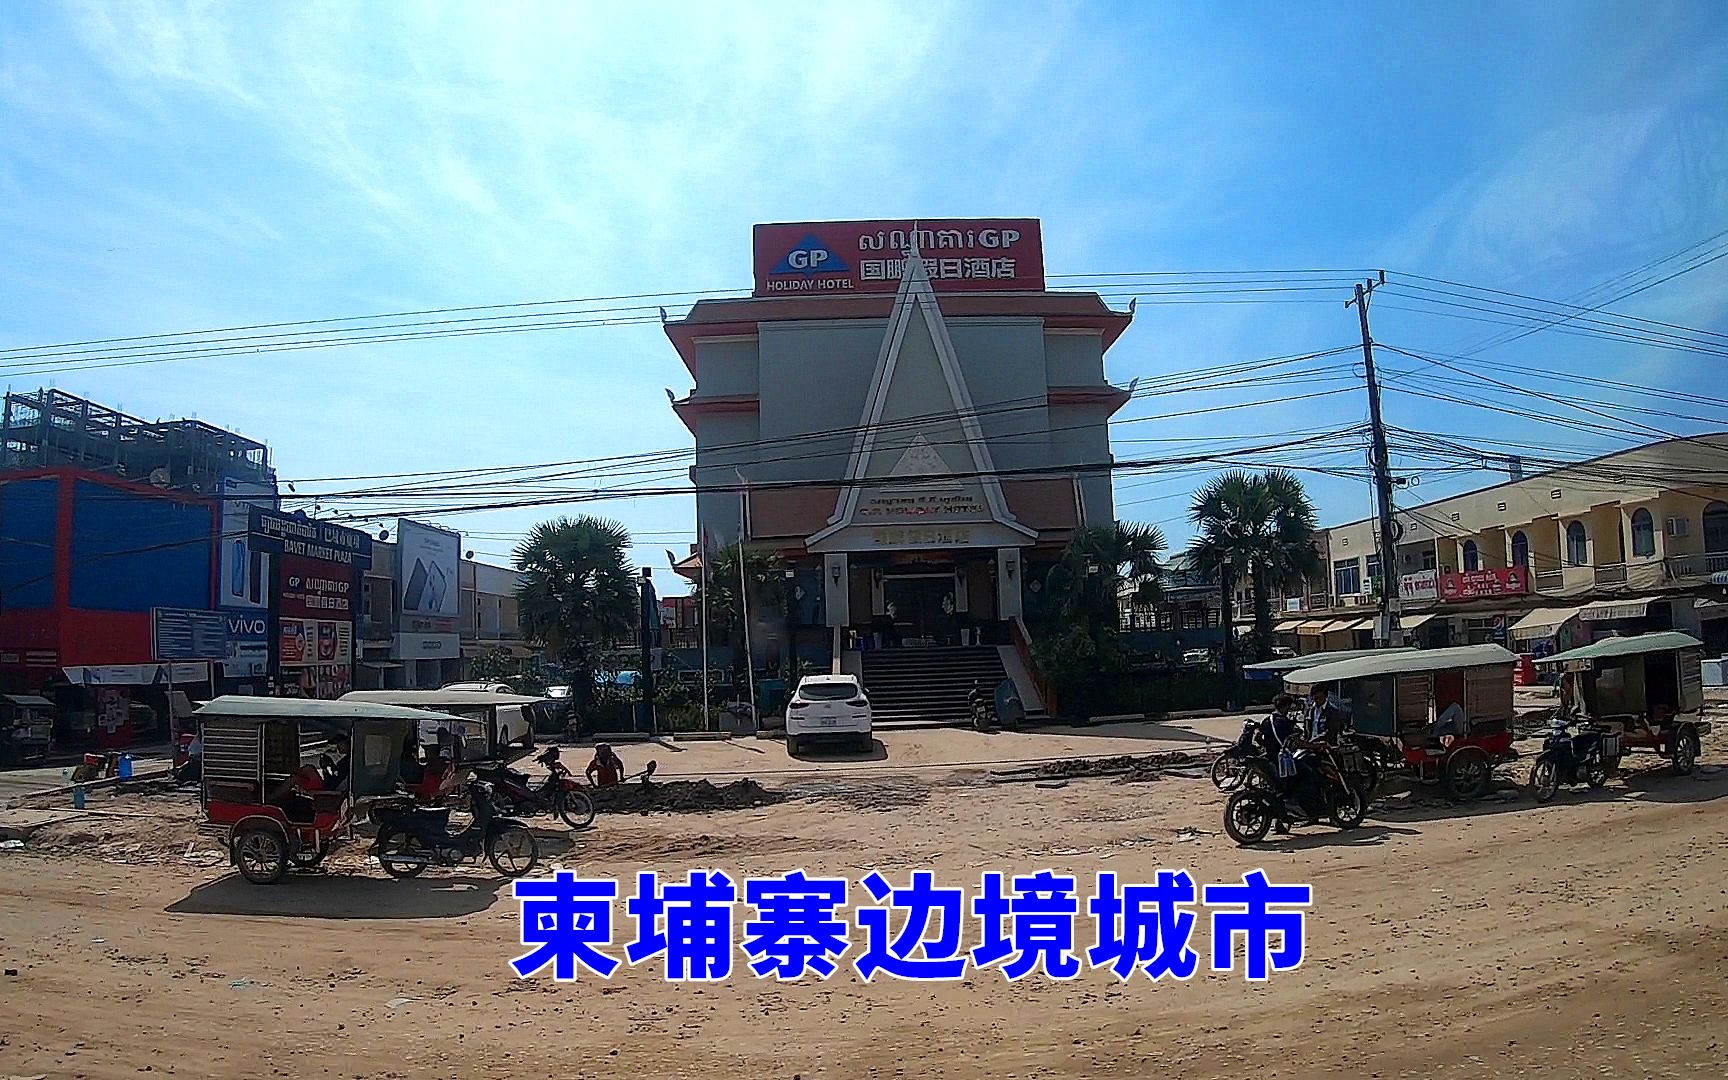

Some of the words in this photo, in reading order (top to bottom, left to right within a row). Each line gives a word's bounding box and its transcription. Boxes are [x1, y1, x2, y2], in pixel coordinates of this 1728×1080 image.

[979, 229, 1020, 250] GP
[787, 249, 829, 269] GP
[766, 279, 814, 291] HOLIDAY
[817, 277, 855, 290] HOTEL
[306, 543, 333, 561] MARKET
[333, 549, 353, 564] PLAZA
[288, 576, 301, 588] GP
[227, 614, 267, 635] vivo
